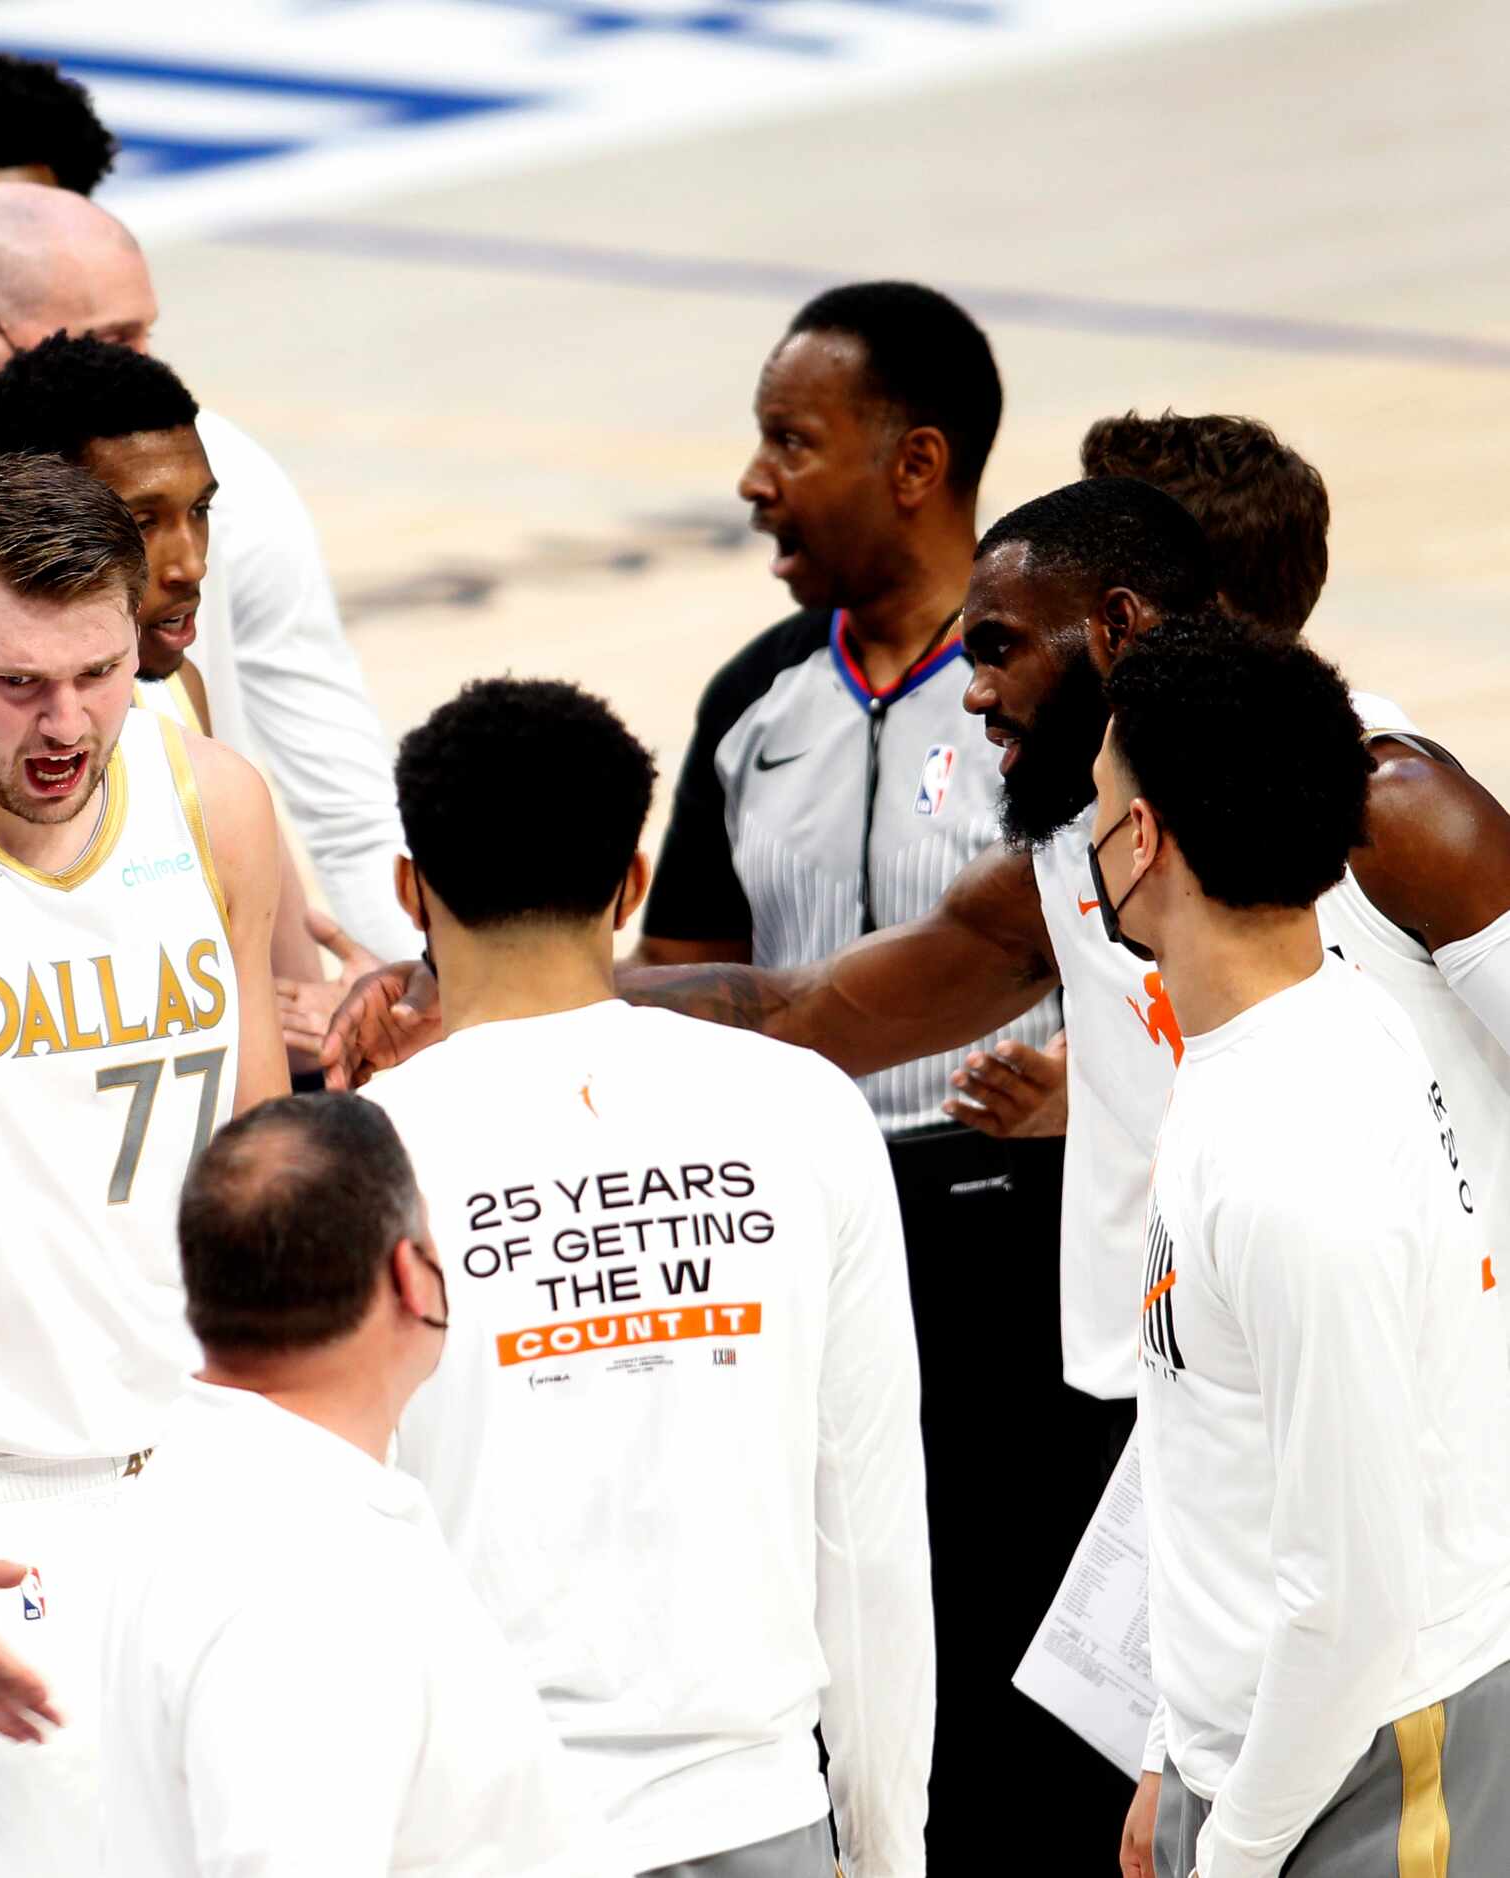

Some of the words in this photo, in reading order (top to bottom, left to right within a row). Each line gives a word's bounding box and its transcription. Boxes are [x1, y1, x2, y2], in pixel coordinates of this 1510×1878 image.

[122, 853, 194, 887] chime
[95, 1045, 229, 1206] 77
[466, 1184, 541, 1231] 25
[554, 1160, 755, 1214] YEARS
[463, 1236, 532, 1278] OF
[552, 1210, 775, 1263] GETTING
[536, 1266, 641, 1312] THE
[660, 1257, 712, 1296] W
[515, 1312, 682, 1358] COUNT
[704, 1308, 745, 1332] IT
